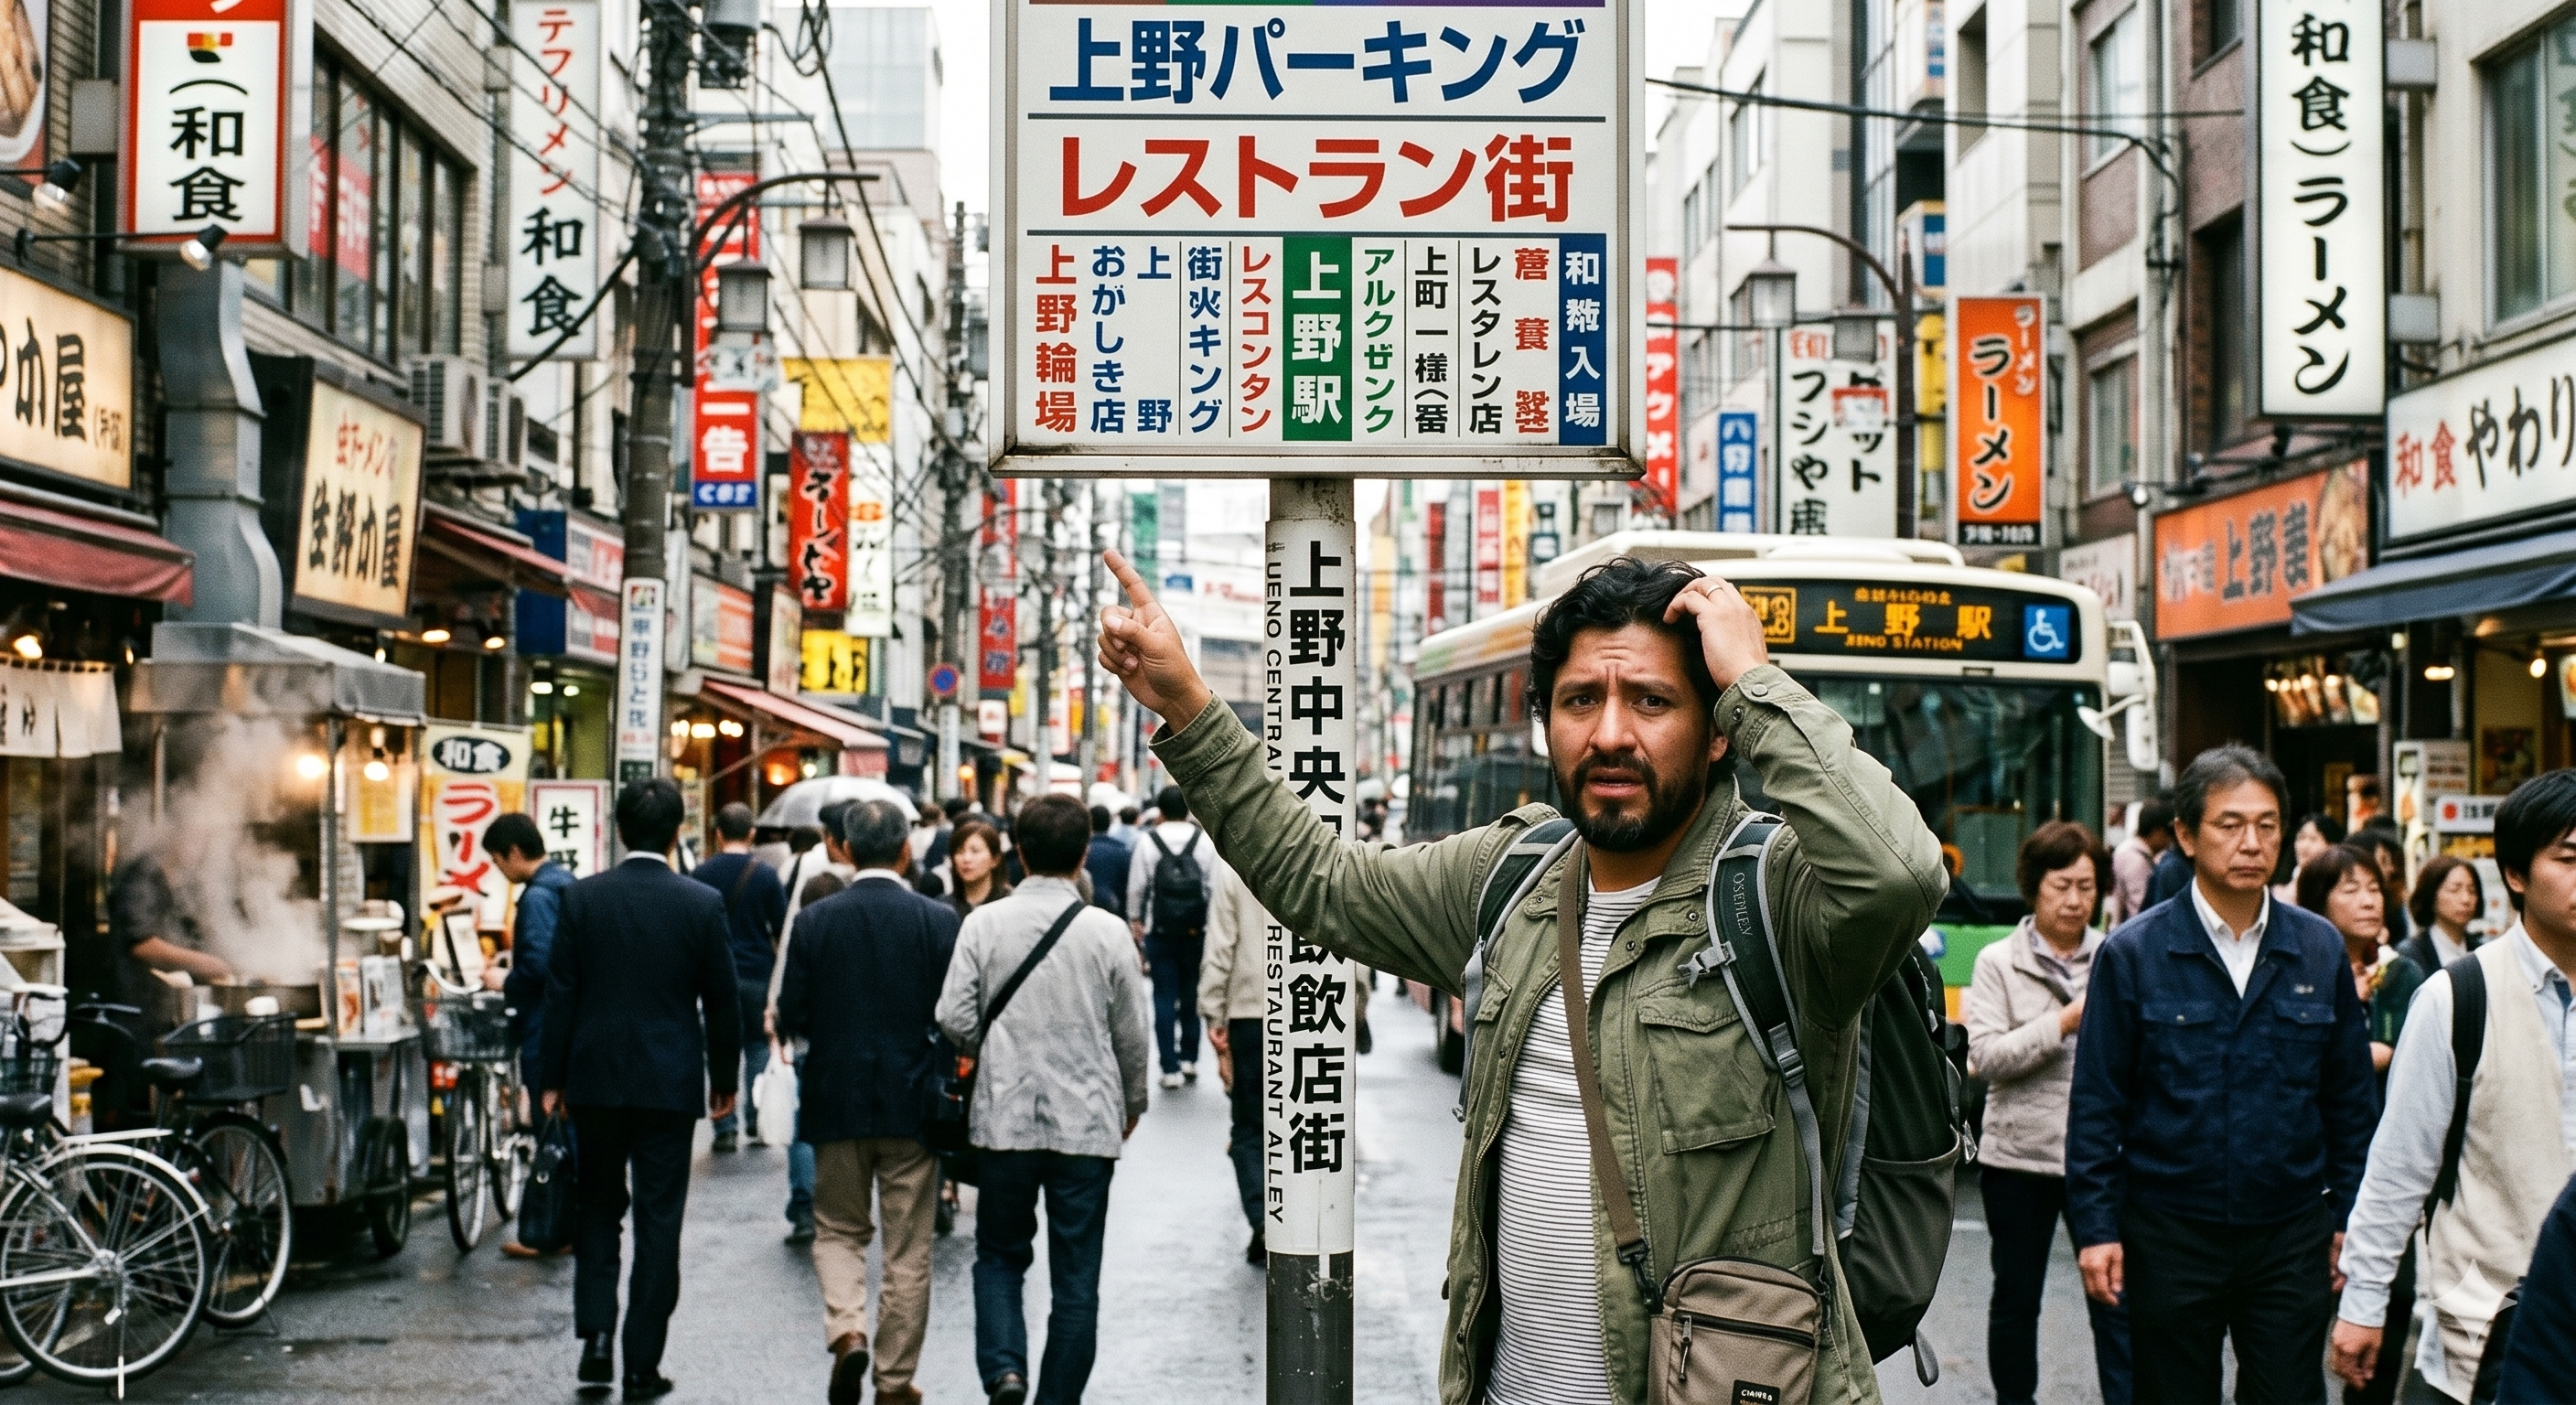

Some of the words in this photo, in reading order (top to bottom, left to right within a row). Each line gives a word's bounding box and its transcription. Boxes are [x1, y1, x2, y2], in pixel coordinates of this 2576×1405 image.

[1048, 16, 1586, 104] 上野パーキング
[1062, 132, 1574, 223] レストラン街
[520, 205, 585, 337] 和食
[1035, 244, 1078, 434] 上野輪場
[1089, 245, 1126, 434] おがしき店
[1240, 245, 1272, 433] レスコンタン
[1291, 252, 1343, 424] 上野駅
[1468, 247, 1503, 434] レスタレン店
[1972, 335, 2012, 511] ラーメン
[1266, 562, 1283, 638] UENO
[1814, 600, 1992, 640] 上野駅
[438, 783, 495, 897] ラーメ
[1267, 924, 1283, 1120] RESTAURANT
[1268, 1130, 1283, 1224] ALLEY
